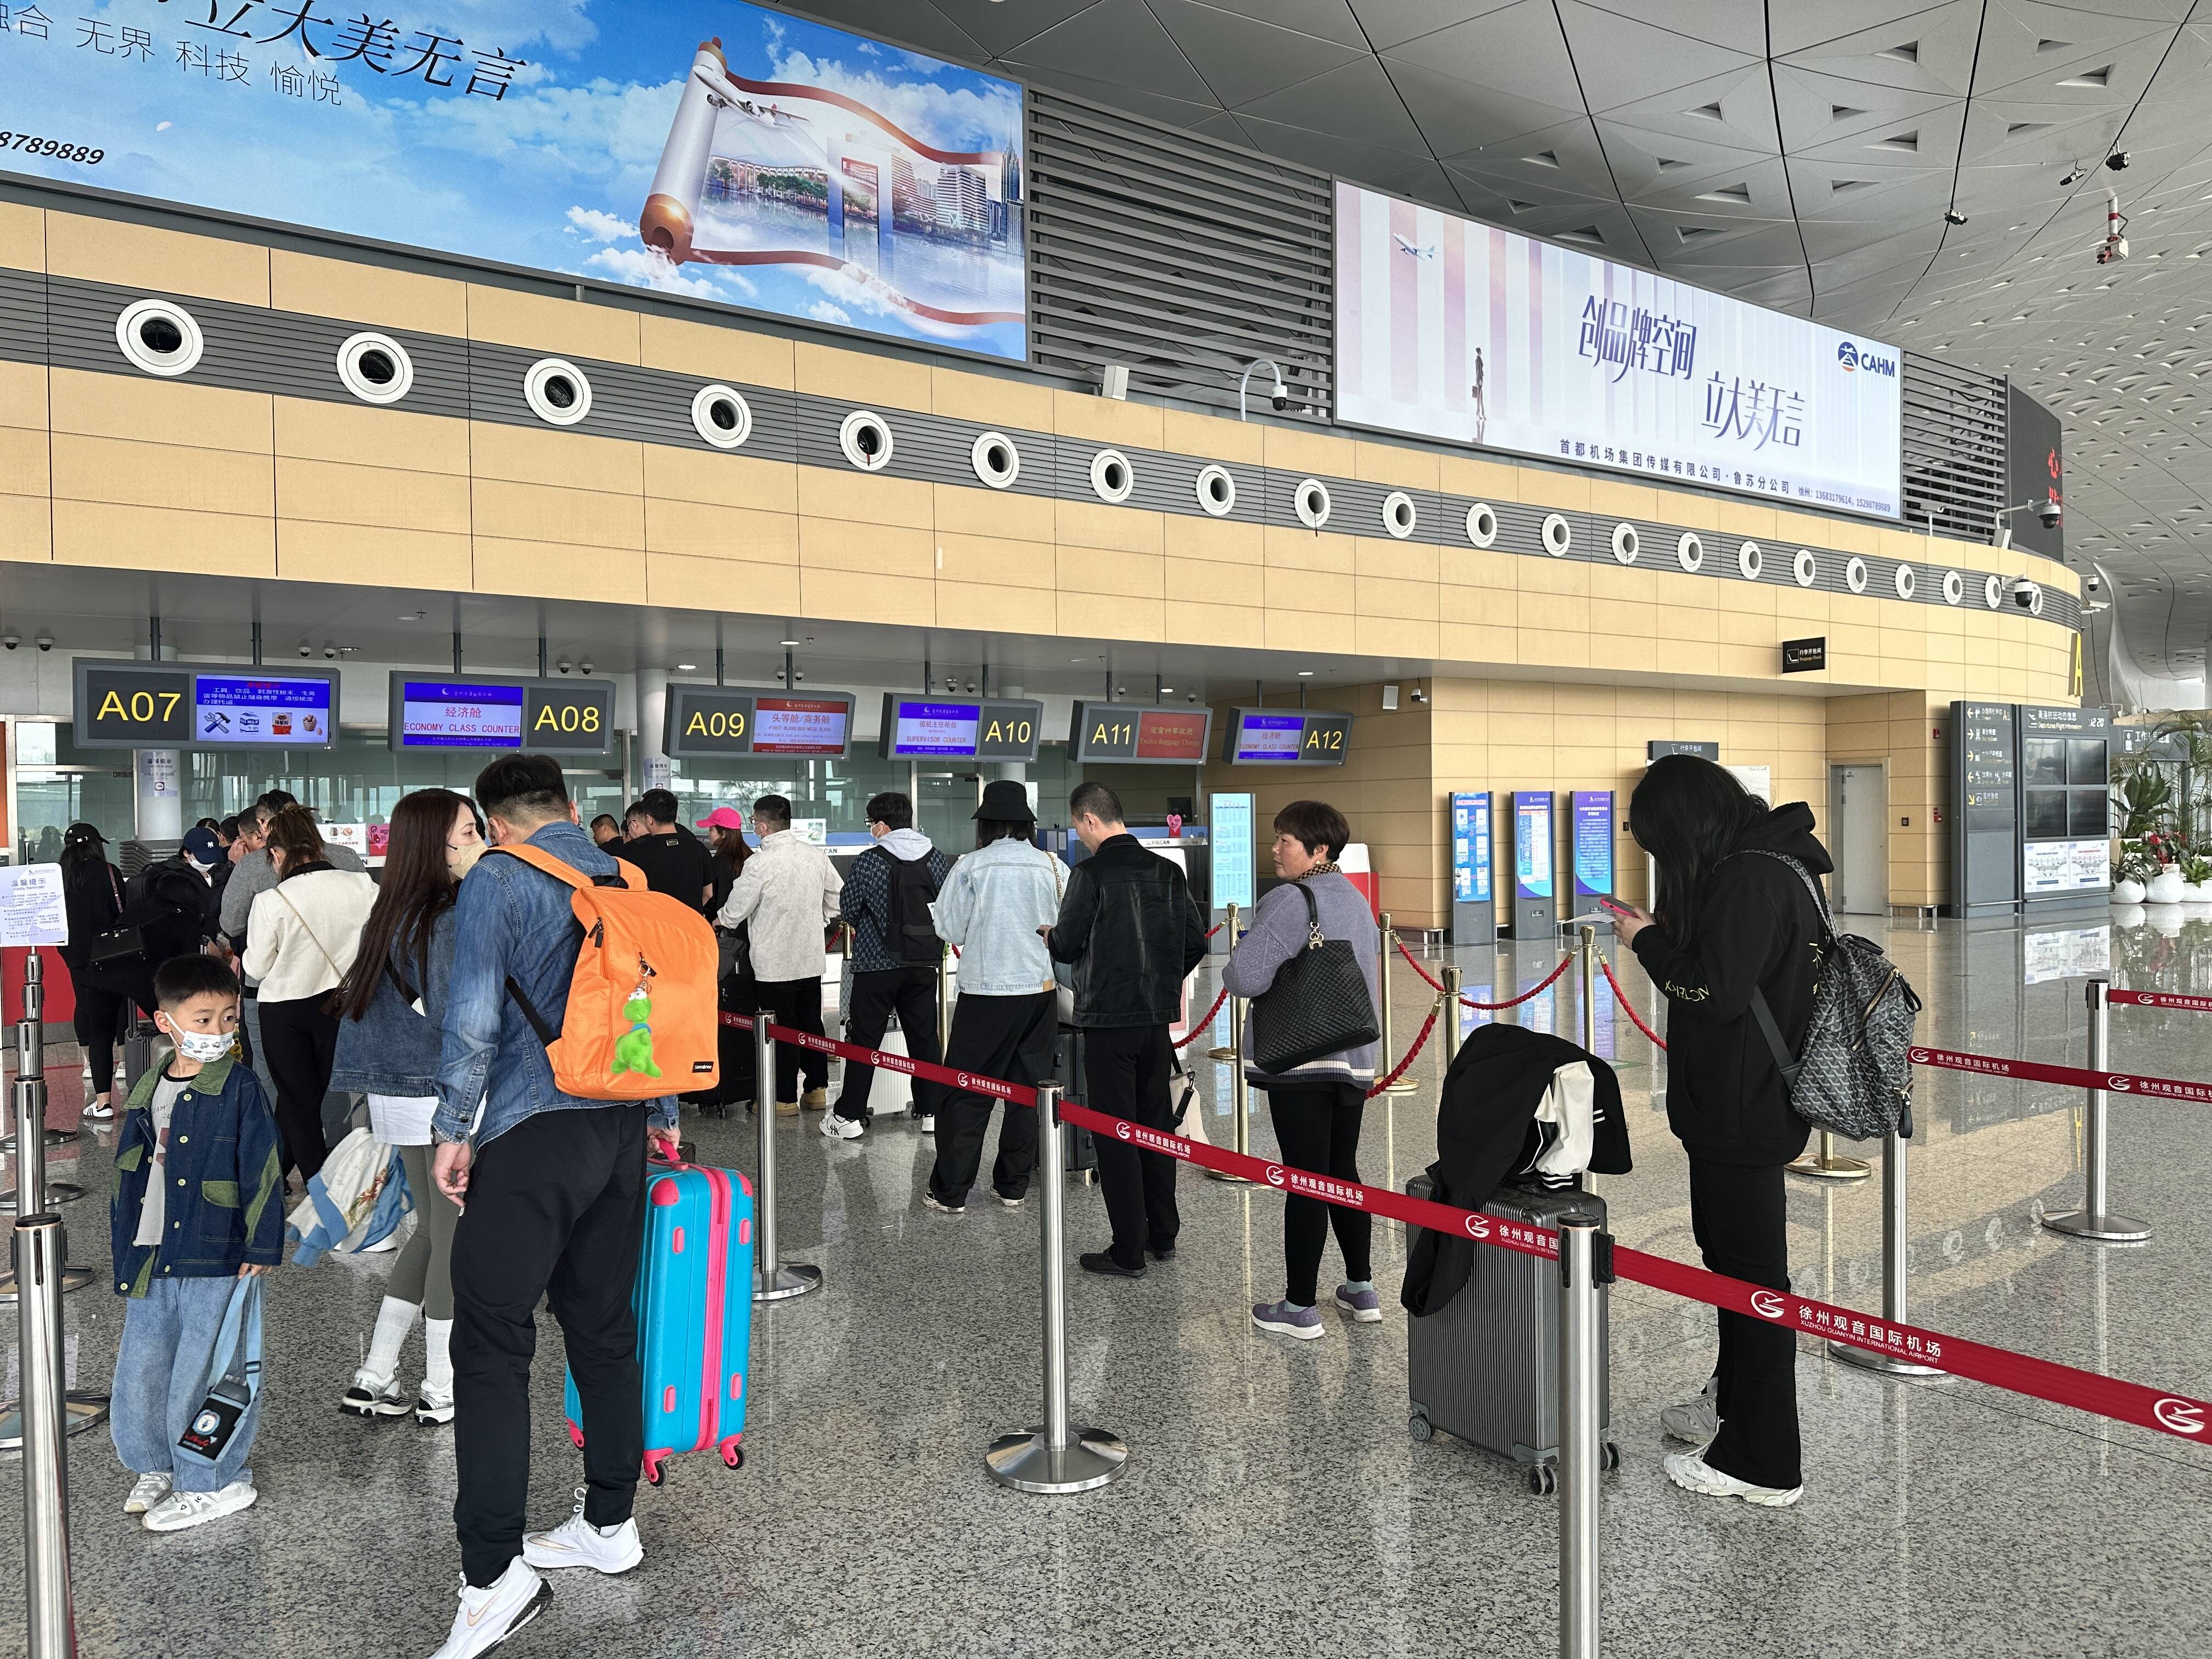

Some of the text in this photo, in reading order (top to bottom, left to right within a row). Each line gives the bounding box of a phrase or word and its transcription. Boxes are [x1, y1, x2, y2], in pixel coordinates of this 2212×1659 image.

[76, 17, 155, 63] 无界
[176, 41, 251, 86] 科技
[269, 60, 342, 106] 愉悦
[1578, 295, 1697, 383] 创品牌空间
[1861, 352, 1895, 378] CAHM
[1701, 370, 1805, 452] 立大美无言
[96, 690, 182, 722] A07
[445, 706, 482, 718] 经济舱
[534, 704, 600, 732] A08
[772, 713, 831, 724] 头等舱/商务舱
[404, 723, 520, 733] ECONOMY CLASS COUNTER
[686, 711, 744, 737] A09
[919, 720, 957, 729] 值机主任柜台
[985, 720, 1031, 743] A10
[1091, 723, 1131, 745] A11
[1158, 738, 1181, 746] Baggage
[1306, 730, 1342, 749] A12
[1936, 1053, 2010, 1073] 徐州观音国际机场
[1135, 1128, 1190, 1155] 徐州观音国际机场
[1290, 1172, 1364, 1202] 徐州观音国际机场
[1501, 1237, 1519, 1246] XUZHOU
[1798, 1305, 1941, 1358] 徐州观音国际机场
[1800, 1319, 1938, 1364] XUZHOU GUANYIN INTERNATIONAL AIRPORT
